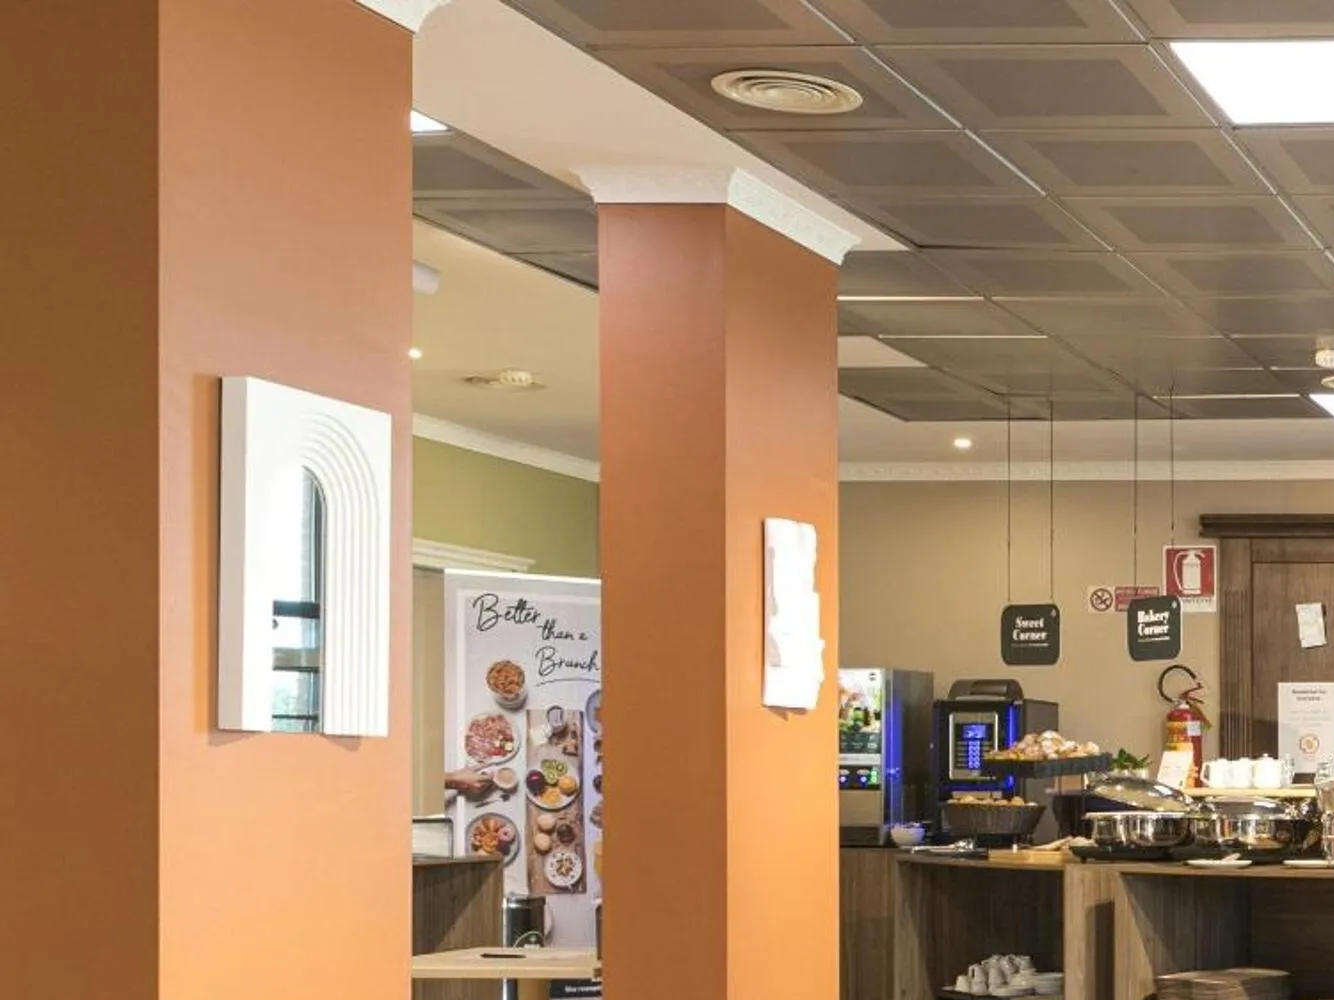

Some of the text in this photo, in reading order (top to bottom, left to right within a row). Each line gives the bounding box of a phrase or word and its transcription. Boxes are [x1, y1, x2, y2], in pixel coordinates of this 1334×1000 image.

[473, 593, 541, 631] Better
[1137, 609, 1170, 624] Bakery
[536, 618, 588, 641] than a
[1015, 616, 1045, 629] Sweet
[1137, 624, 1169, 636] Corner
[1012, 629, 1048, 641] Corner
[535, 645, 600, 677] Brunch
